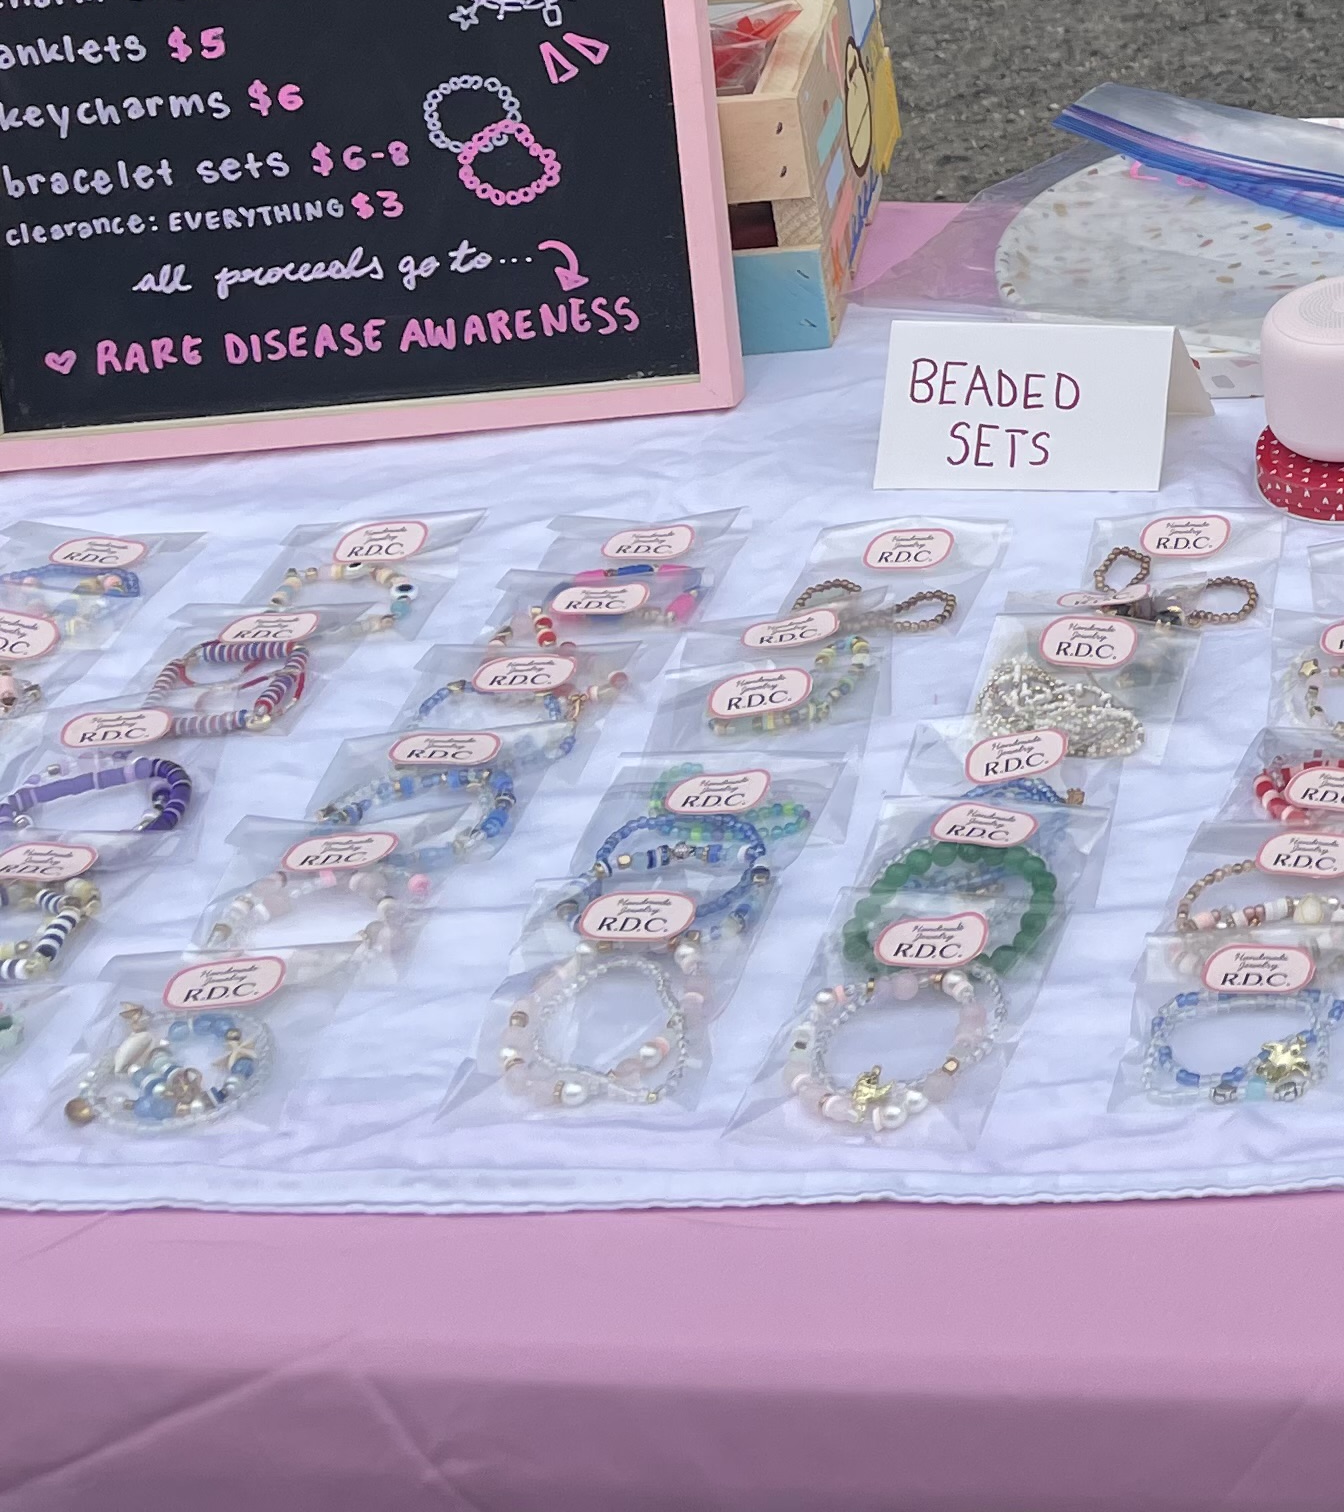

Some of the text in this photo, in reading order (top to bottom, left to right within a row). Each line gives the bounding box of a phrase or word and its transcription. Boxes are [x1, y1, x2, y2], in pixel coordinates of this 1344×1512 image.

[0, 26, 225, 69] anklets $5
[0, 80, 303, 139] keycharms $6
[3, 159, 173, 197] bracelet
[197, 152, 289, 183] sets
[6, 191, 403, 246] clearance: EVERYTHING $3
[132, 264, 192, 293] all
[215, 247, 383, 299] proceeds
[398, 256, 440, 290] go
[97, 297, 639, 375] RARE DISEASE AWARENESS
[909, 357, 1081, 411] BEADED
[947, 422, 1051, 469] SETS
